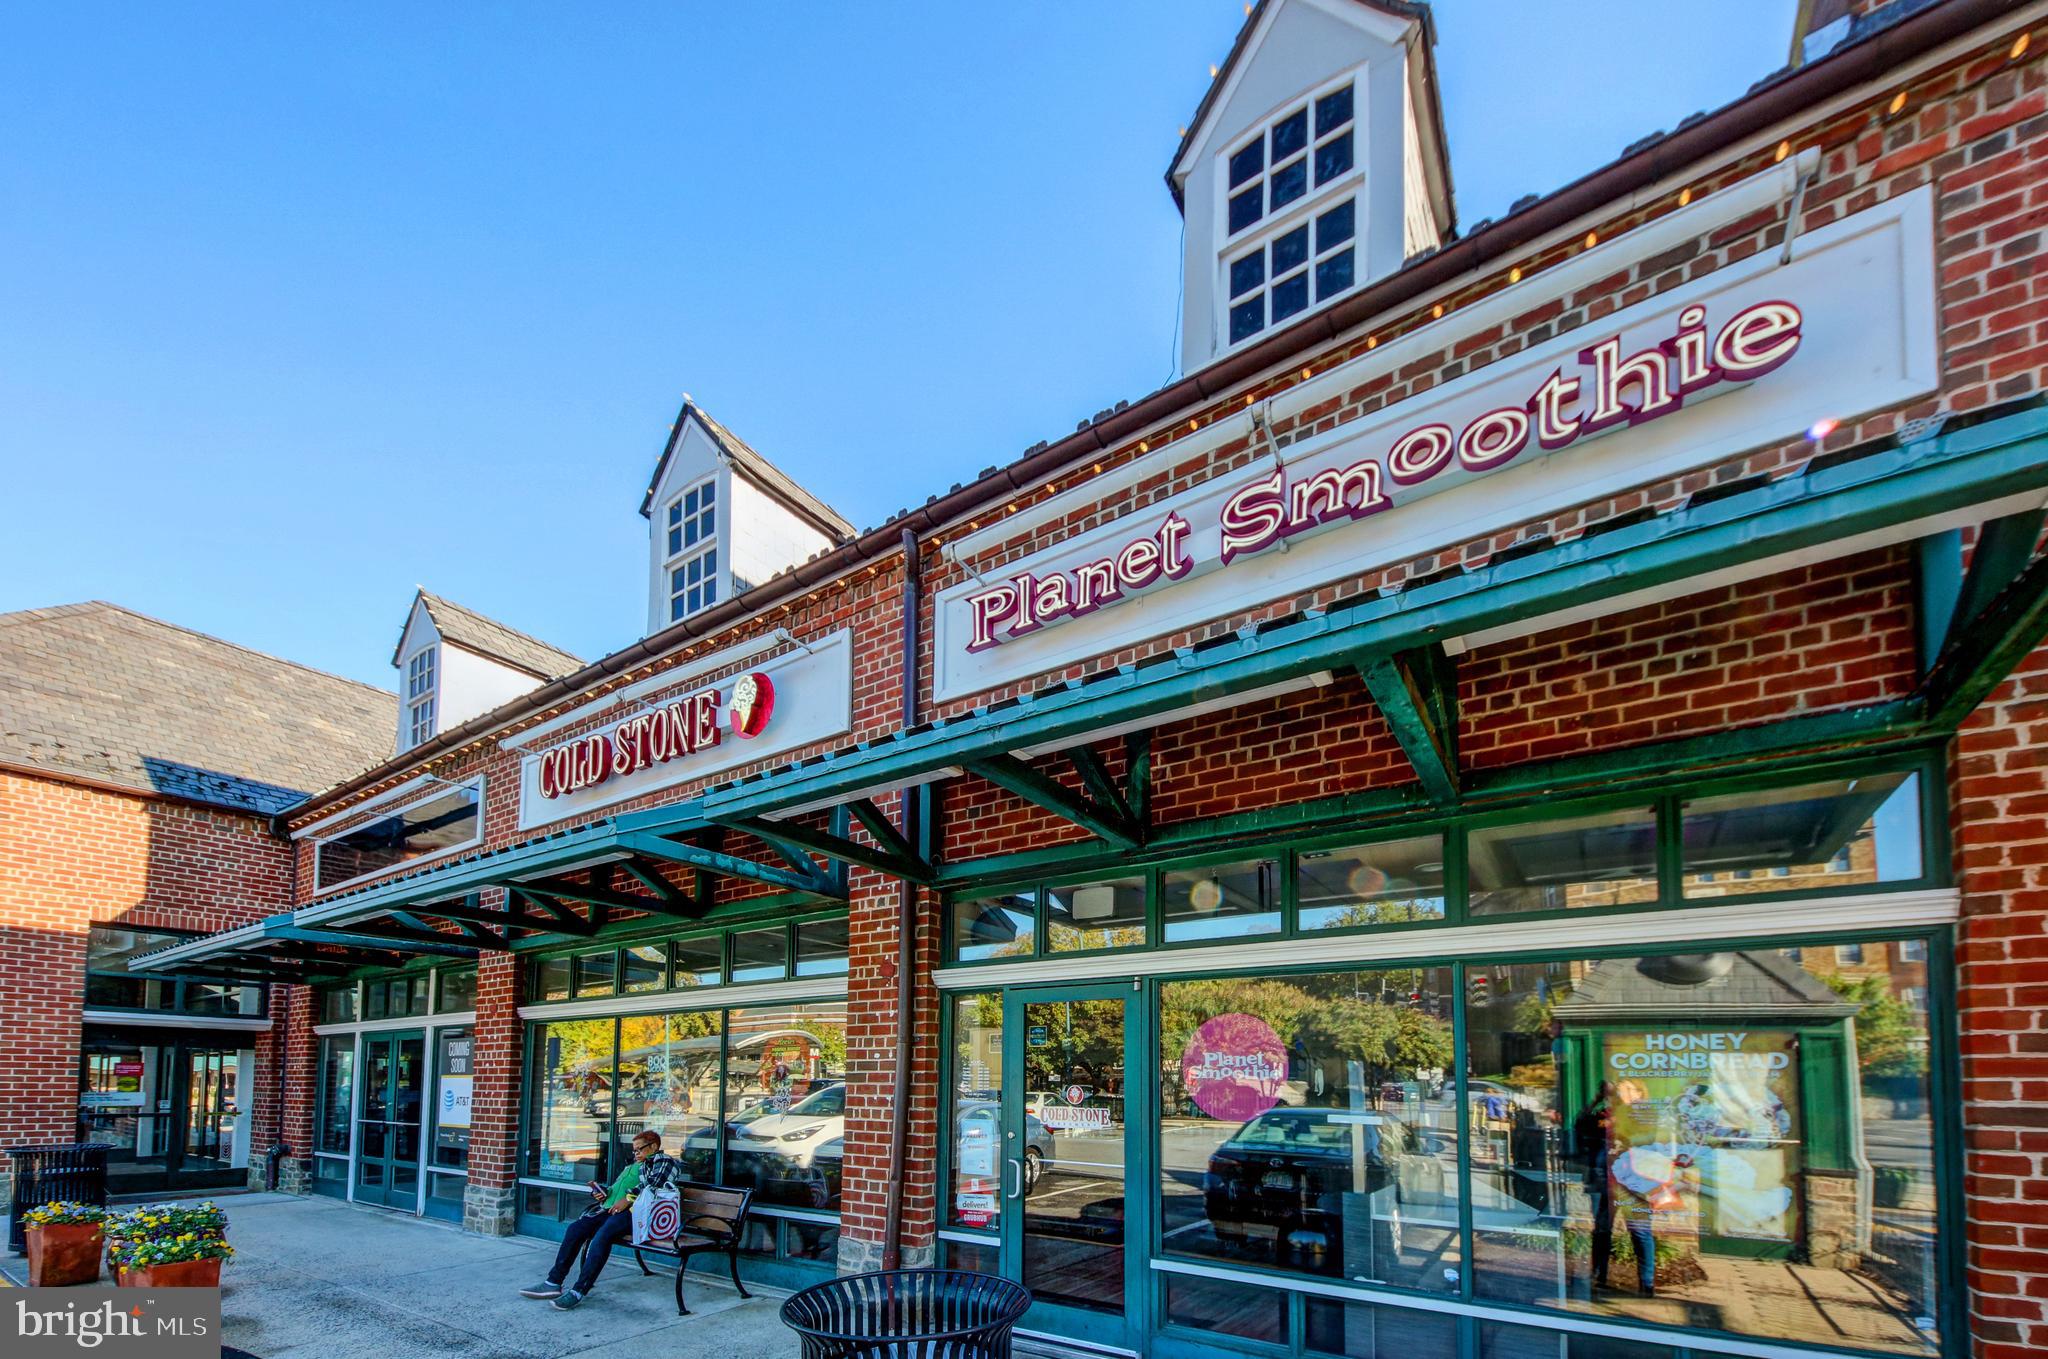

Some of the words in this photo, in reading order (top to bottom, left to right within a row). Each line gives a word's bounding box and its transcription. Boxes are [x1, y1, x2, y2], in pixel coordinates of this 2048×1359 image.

[965, 510, 1194, 654] Planet
[1221, 300, 1803, 567] Smoothie
[539, 732, 611, 799] COLD
[611, 688, 721, 776] STONE
[448, 1041, 470, 1056] COMING
[1645, 1033, 1748, 1050] HONEY
[450, 1058, 466, 1073] SOON
[1203, 1051, 1266, 1067] Planet
[1609, 1052, 1790, 1070] CORNBREAD
[456, 1096, 470, 1106] AT&T
[1040, 1107, 1069, 1123] COLD
[1071, 1108, 1110, 1126] STONE
